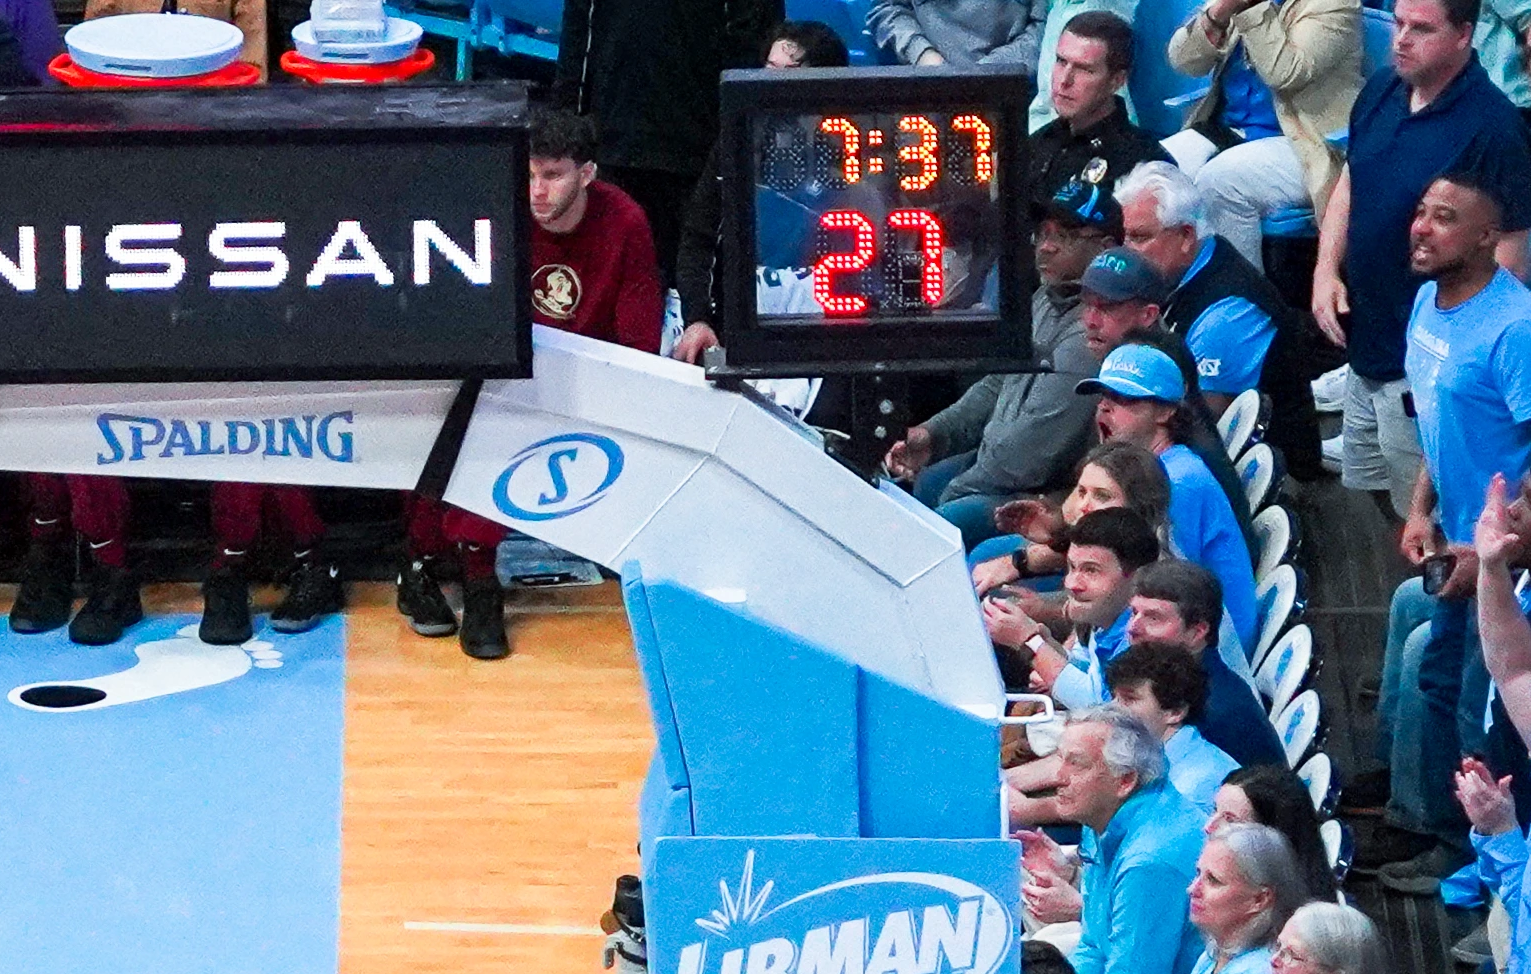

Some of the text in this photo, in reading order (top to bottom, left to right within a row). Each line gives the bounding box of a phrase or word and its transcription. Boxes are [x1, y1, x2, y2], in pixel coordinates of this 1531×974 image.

[818, 113, 994, 192] 7:37
[813, 209, 944, 315] 27
[96, 411, 354, 465] SPALDING
